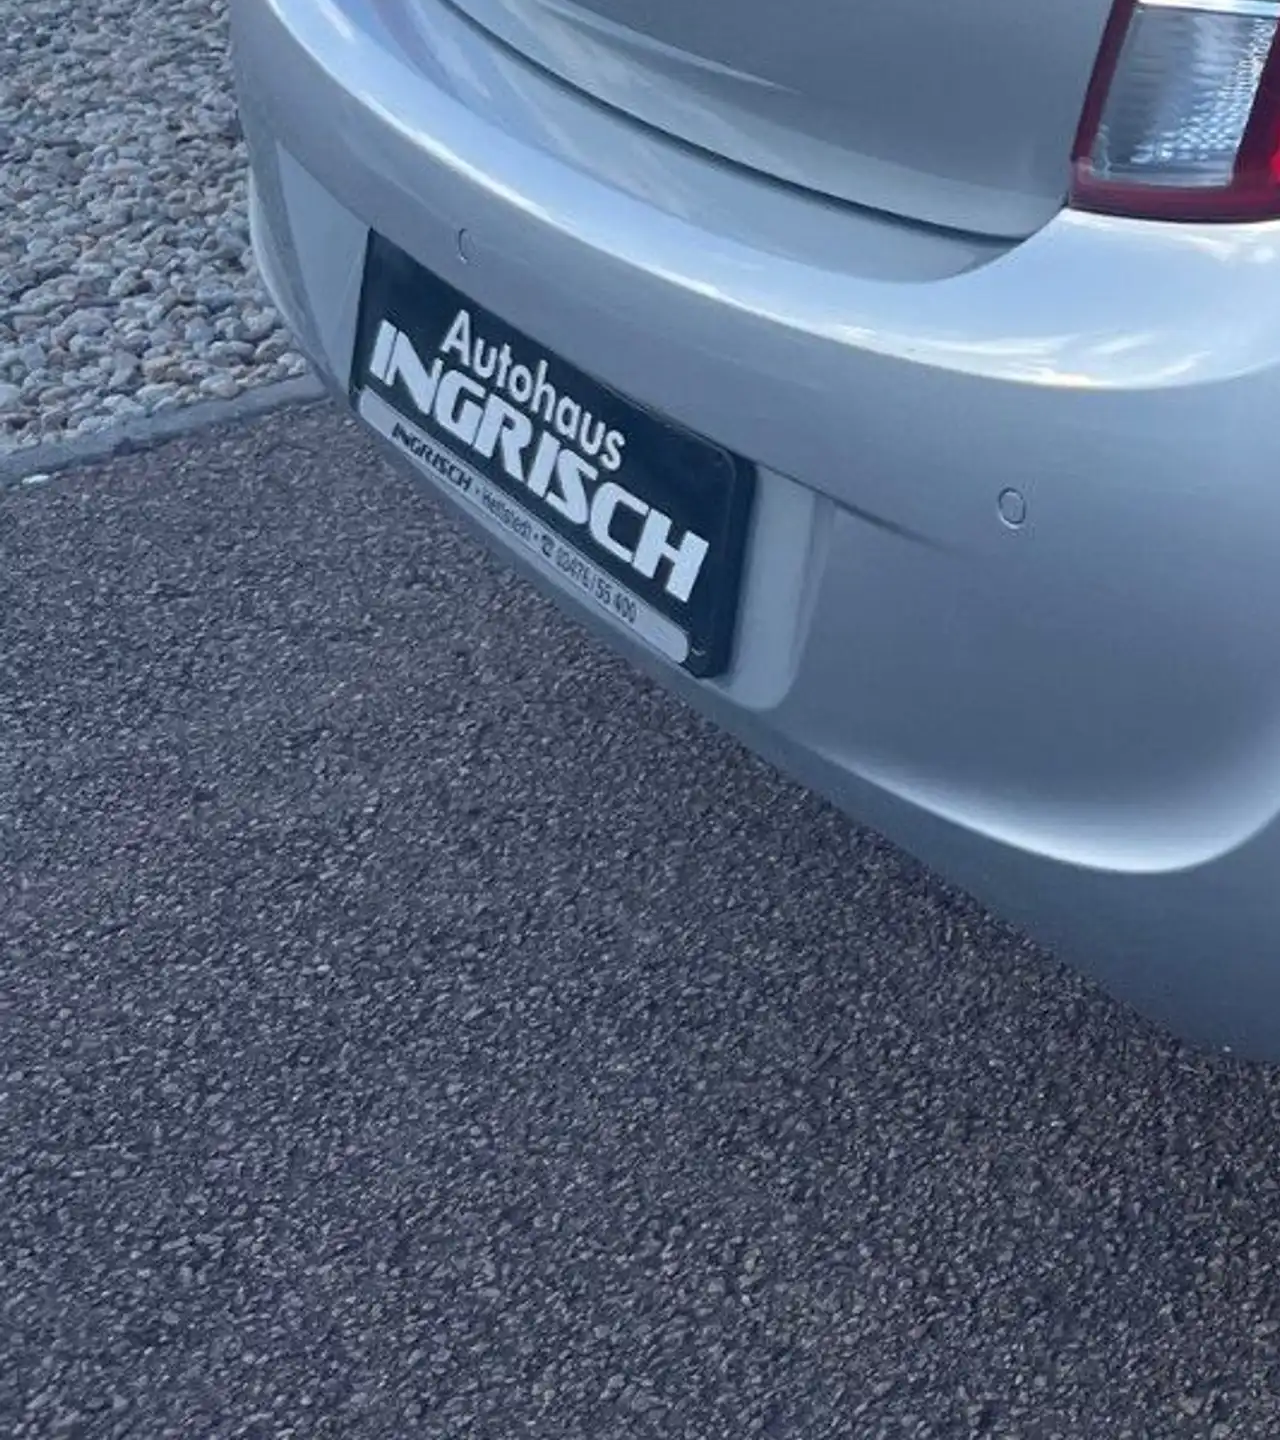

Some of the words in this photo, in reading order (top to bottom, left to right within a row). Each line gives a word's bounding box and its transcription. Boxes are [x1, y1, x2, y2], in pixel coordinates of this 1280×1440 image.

[369, 319, 710, 603] INGRISCH
[391, 422, 473, 492] INGRISCH
[440, 309, 626, 471] Autohaus
